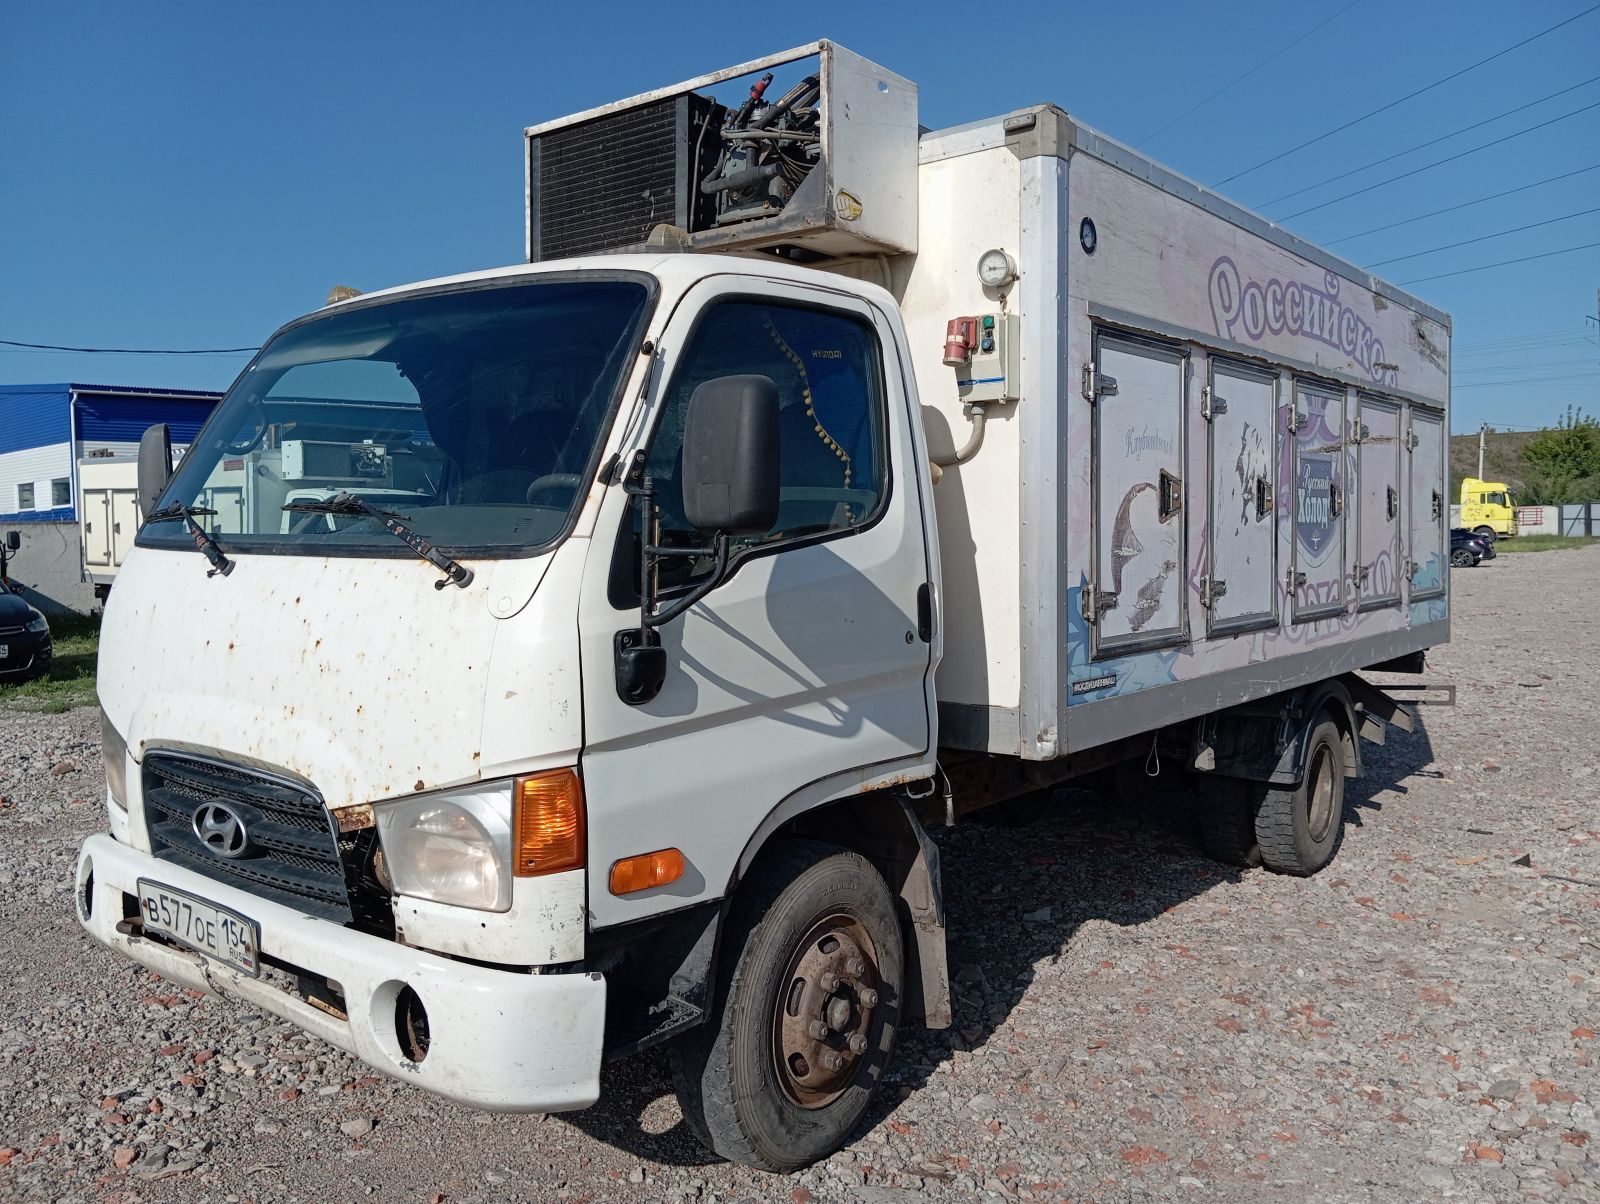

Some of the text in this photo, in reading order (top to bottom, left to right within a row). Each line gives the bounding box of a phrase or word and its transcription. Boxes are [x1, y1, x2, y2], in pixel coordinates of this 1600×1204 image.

[811, 349, 842, 359] HYUNDAI
[1303, 464, 1329, 496] Русский
[229, 947, 244, 961] RUS
